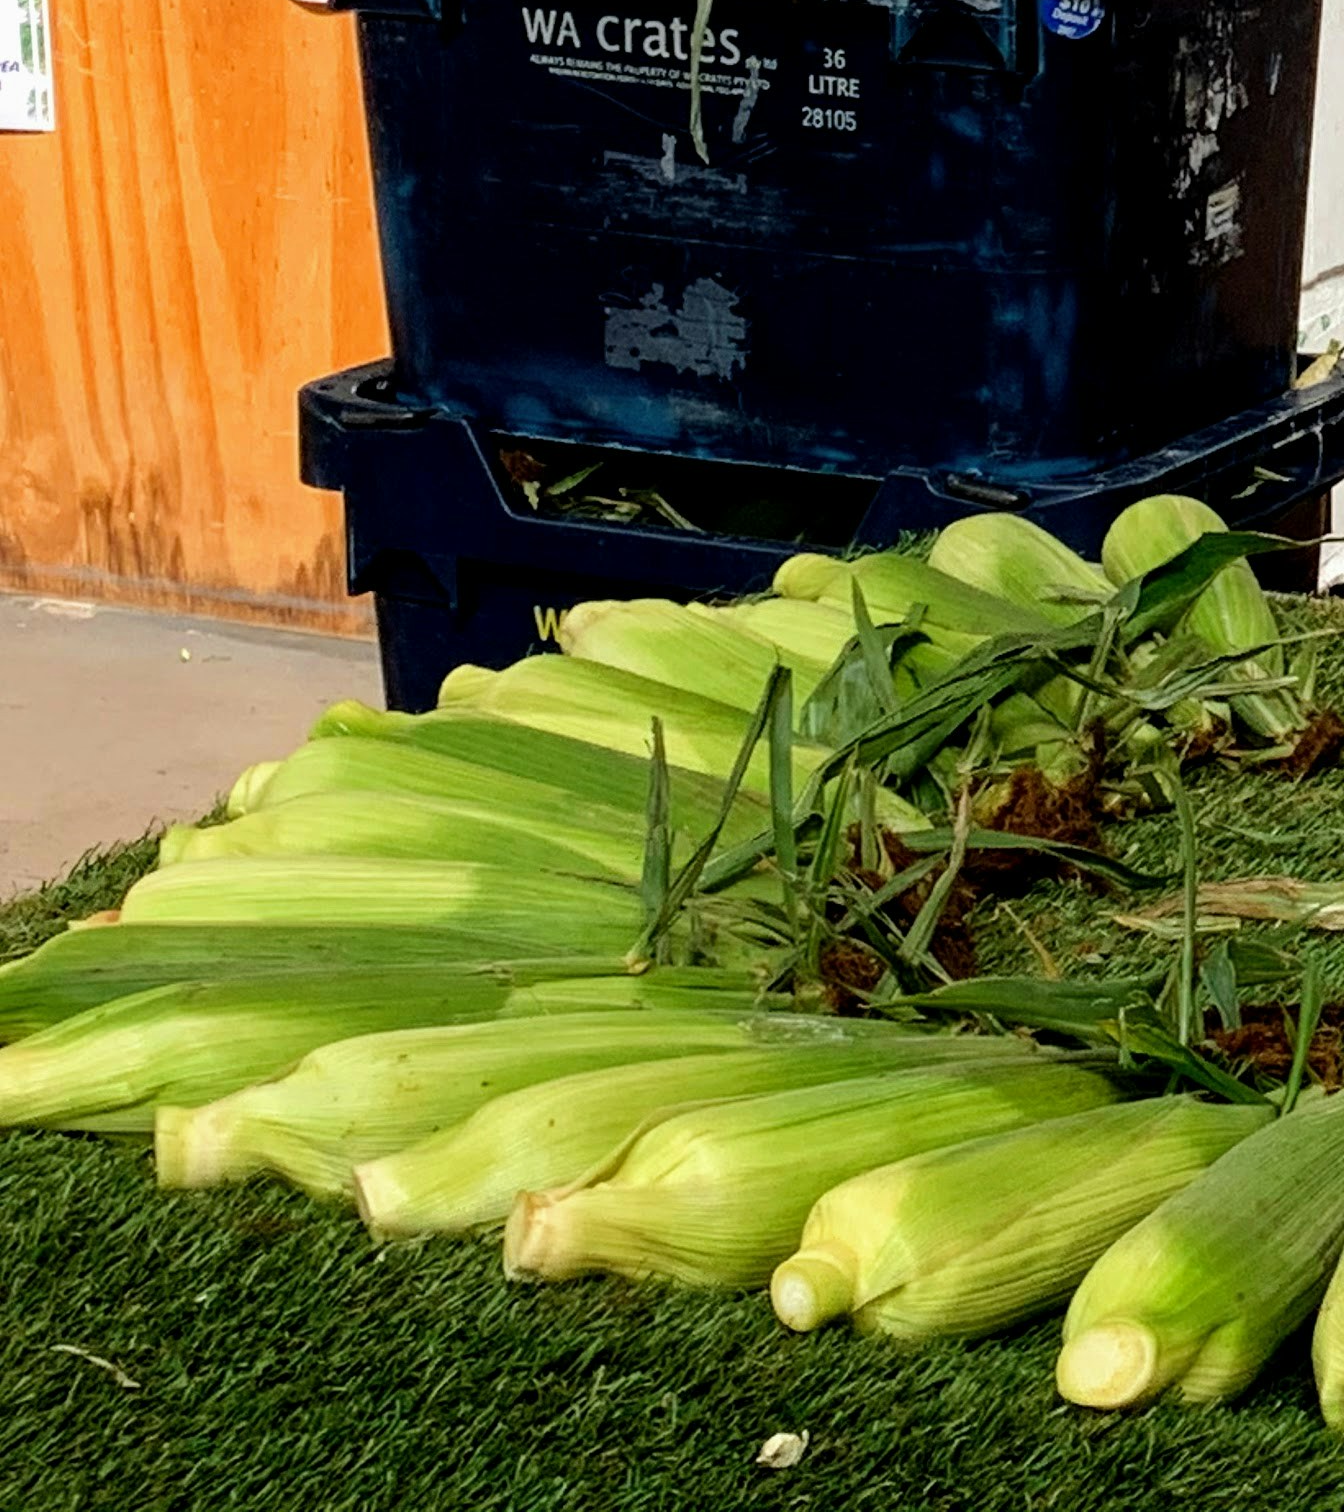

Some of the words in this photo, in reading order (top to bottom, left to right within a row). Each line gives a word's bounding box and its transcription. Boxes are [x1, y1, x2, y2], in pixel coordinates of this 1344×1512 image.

[522, 7, 581, 48] WA
[596, 16, 741, 65] crates
[0, 60, 20, 72] EA
[530, 53, 565, 67] ALWAYS
[605, 61, 622, 73] THE
[668, 69, 680, 79] OF
[823, 47, 846, 69] 36
[808, 74, 860, 98] LITRE
[801, 105, 857, 131] 28105
[533, 604, 568, 643] W
